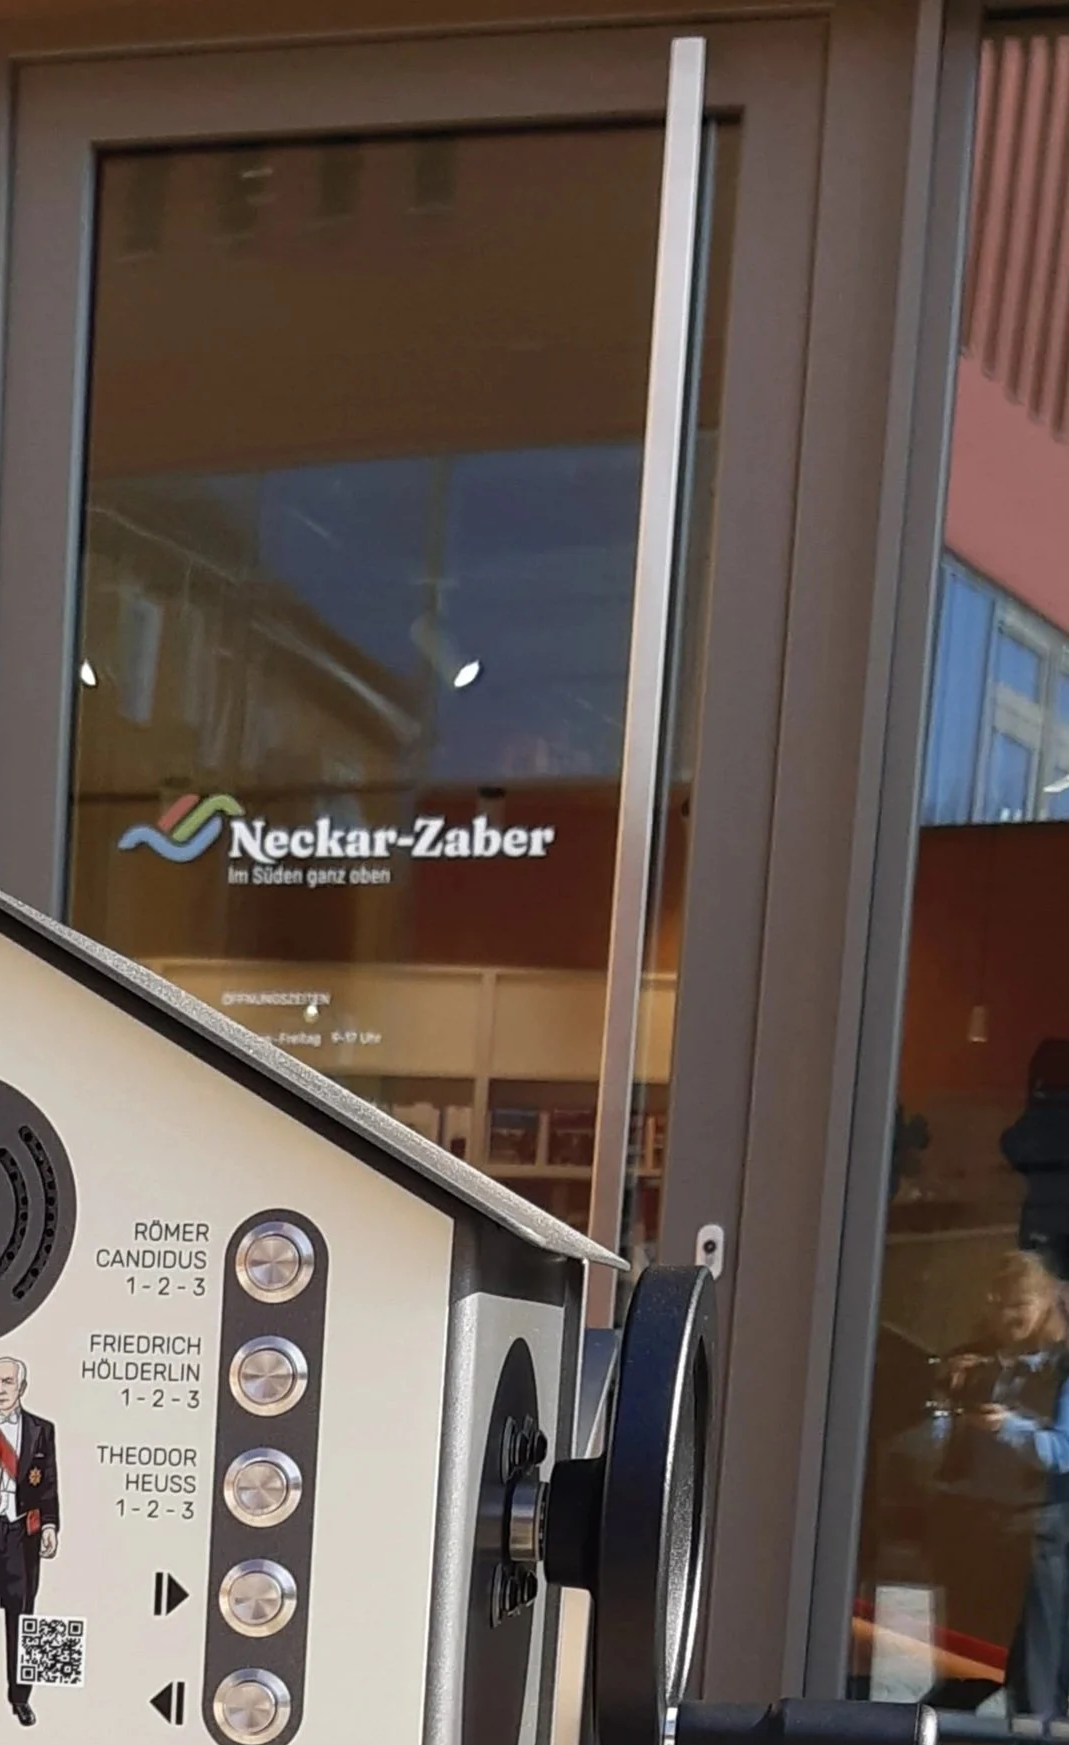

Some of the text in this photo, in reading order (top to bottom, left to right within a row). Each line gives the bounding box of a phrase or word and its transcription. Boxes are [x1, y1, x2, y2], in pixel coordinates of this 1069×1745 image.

[228, 815, 555, 864] Neckar-Zaber
[228, 865, 391, 889] Im Süden ganz oben
[134, 1219, 210, 1243] RÖMER
[96, 1248, 207, 1270] CANDIDUS
[90, 1333, 202, 1356] FRIEDRICH
[81, 1357, 201, 1382] HÖLDERLIN
[96, 1445, 197, 1468] THEODOR
[125, 1472, 197, 1494] HEUSS
